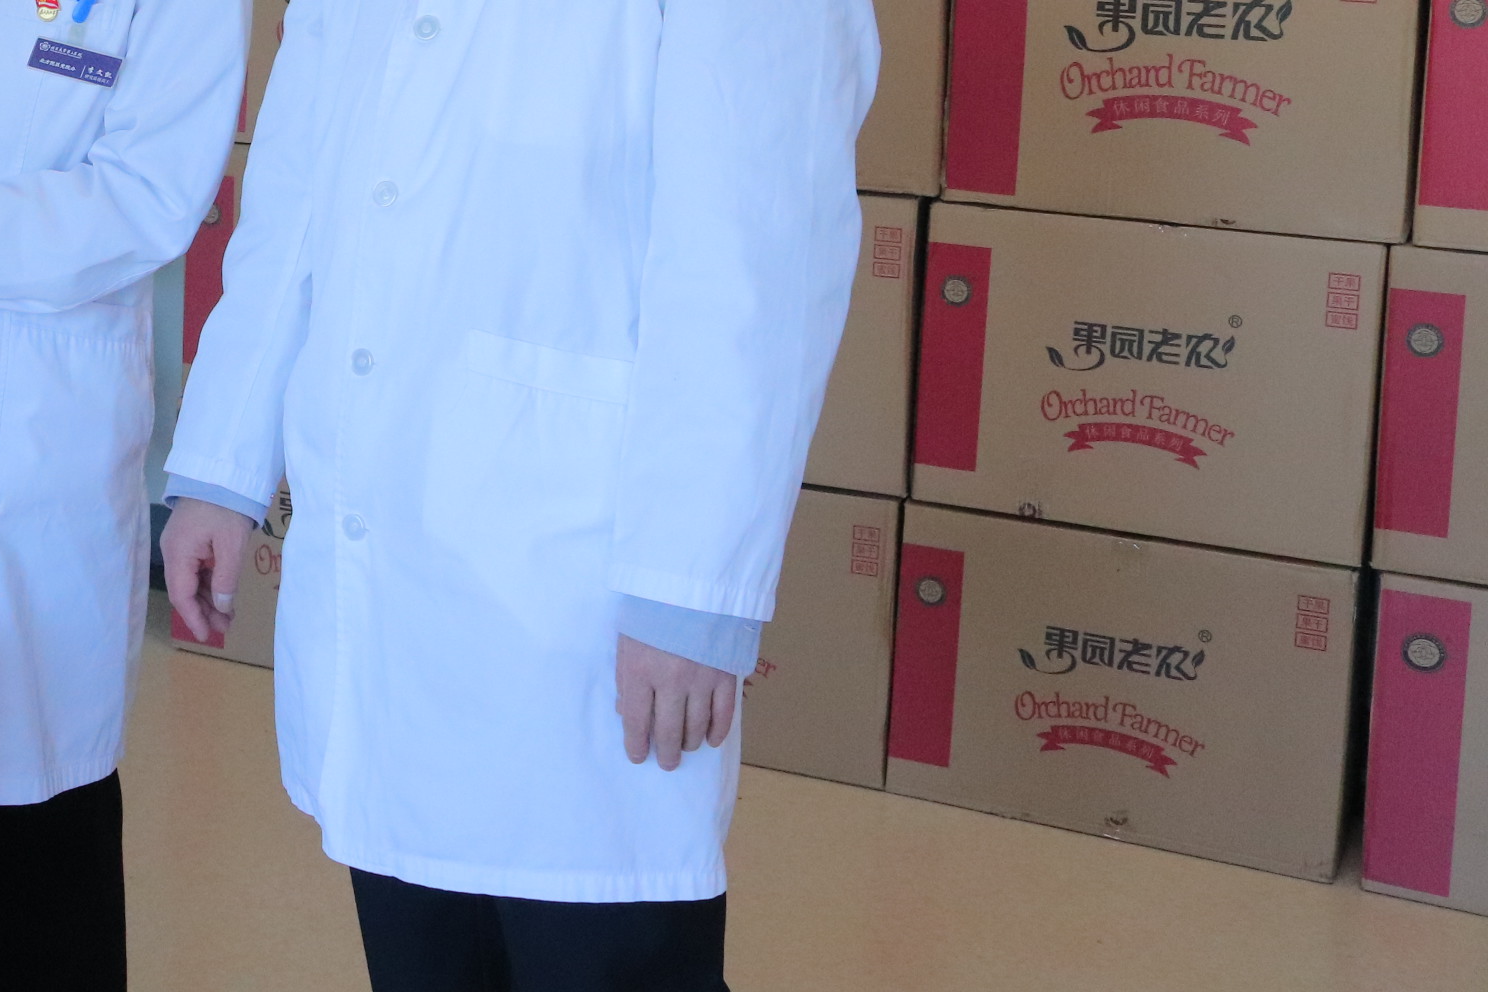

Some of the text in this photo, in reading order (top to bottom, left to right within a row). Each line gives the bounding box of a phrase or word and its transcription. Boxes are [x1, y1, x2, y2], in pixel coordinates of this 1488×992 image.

[1060, 54, 1292, 117] Orchard Farmer
[1045, 320, 1236, 371] 果园老农
[1040, 389, 1235, 448] Orchard Farmer
[1017, 625, 1206, 681] 果园老农
[1014, 691, 1205, 758] Orchard Farmer
